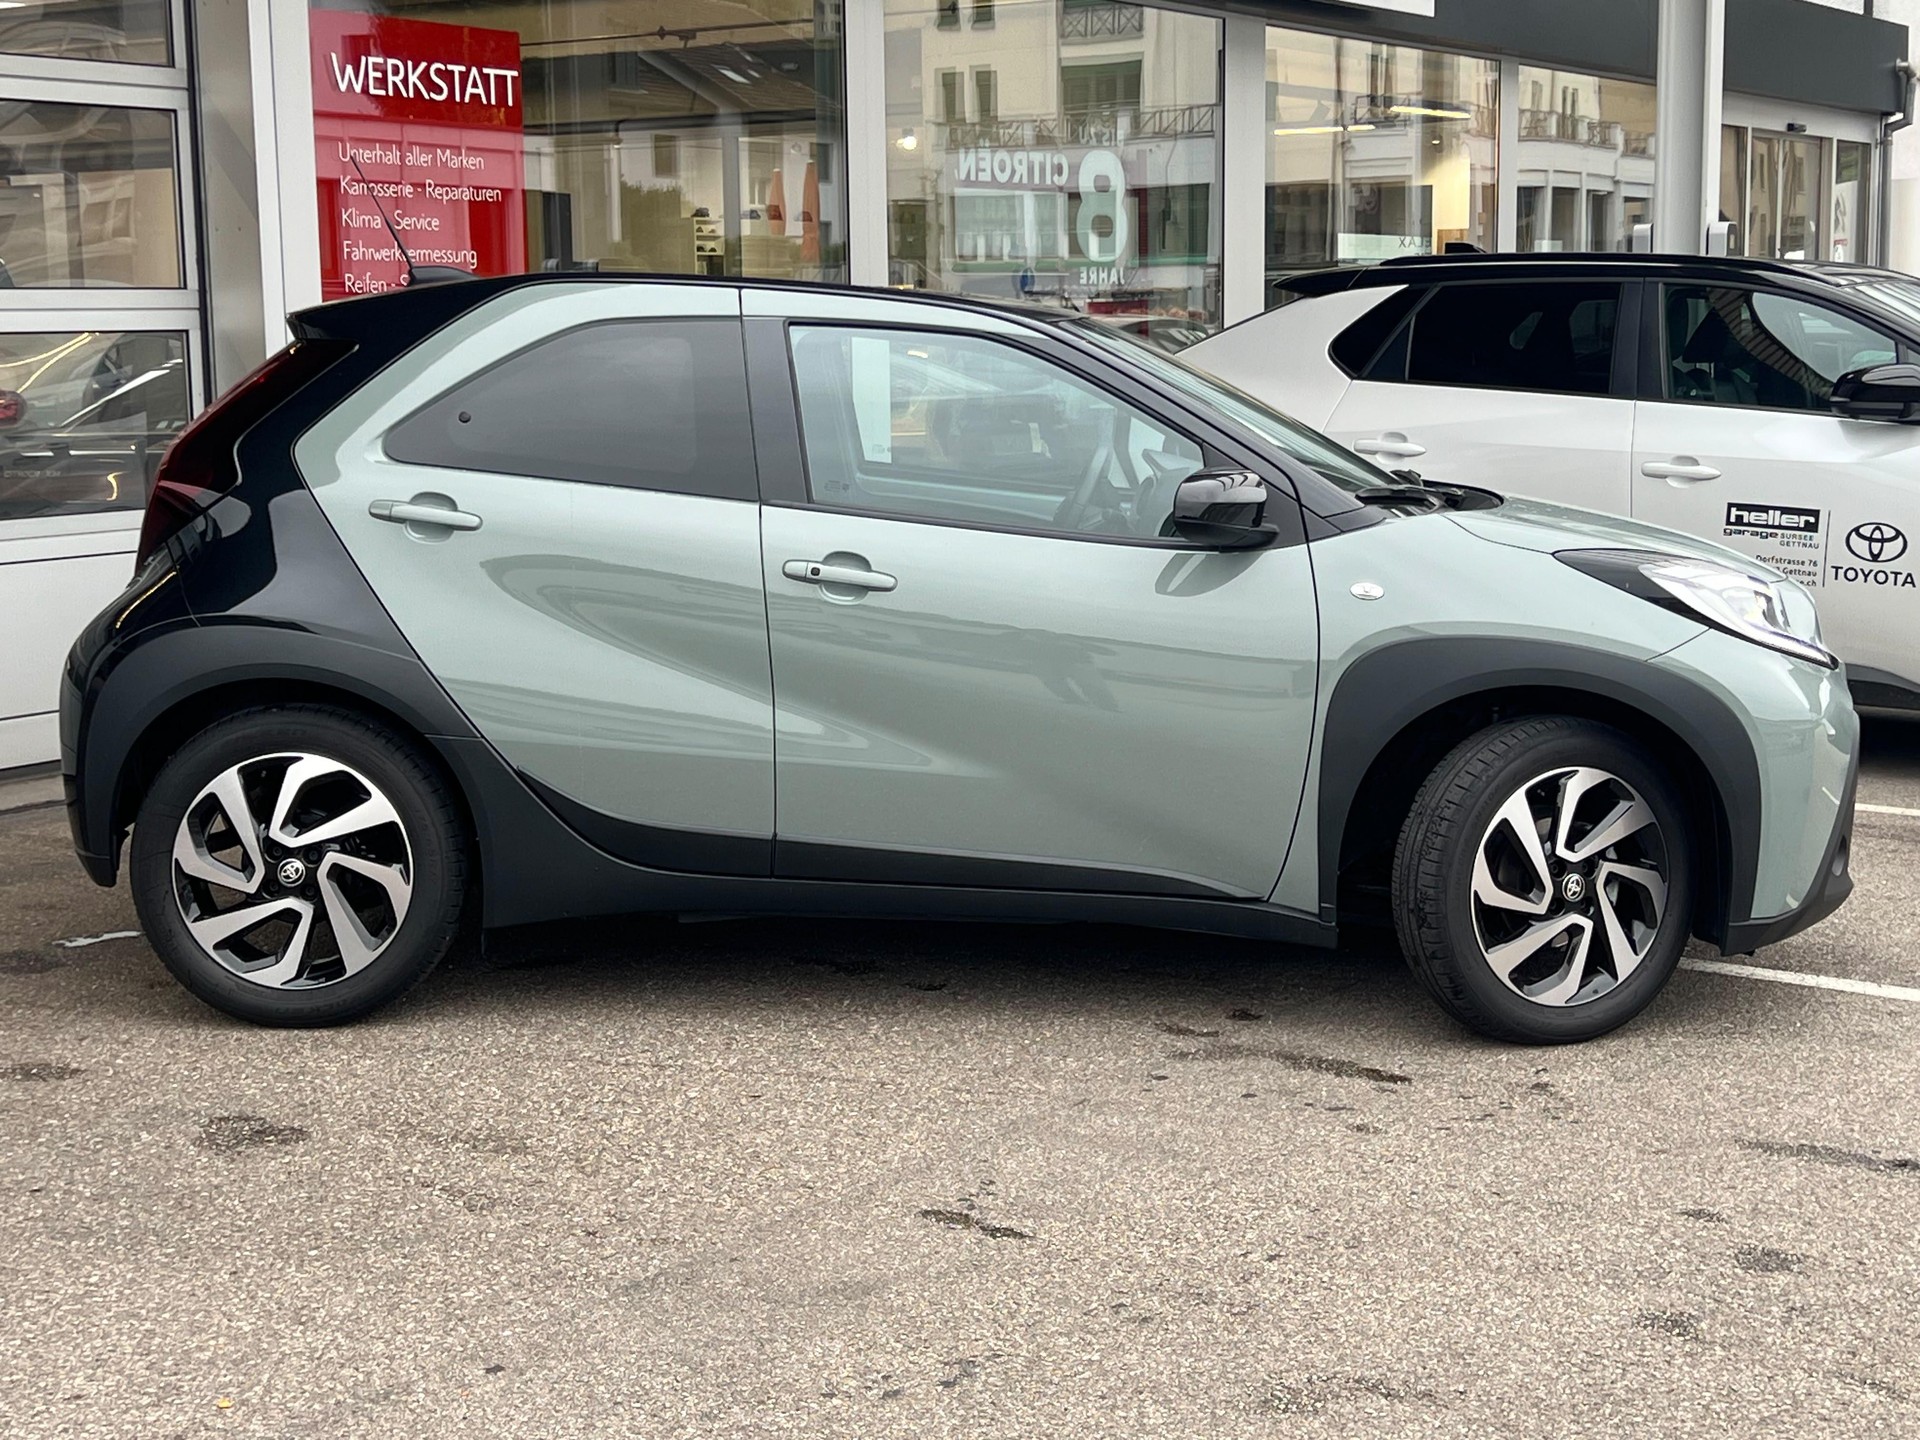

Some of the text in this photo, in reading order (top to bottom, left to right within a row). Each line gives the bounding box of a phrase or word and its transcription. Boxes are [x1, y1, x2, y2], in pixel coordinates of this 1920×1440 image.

[330, 52, 519, 107] WERKSTATT
[338, 141, 485, 170] Unterhalt aller Marken
[425, 179, 502, 205] Reparaturen
[341, 207, 440, 231] Klima Service
[345, 272, 387, 294] Reifen
[1729, 506, 1816, 528] heller
[1723, 527, 1815, 542] garage SURSEE
[1779, 540, 1820, 550] GETTNAU
[1782, 566, 1818, 578] Gettnau
[1807, 559, 1819, 568] 76
[1830, 565, 1917, 588] TOYOTA
